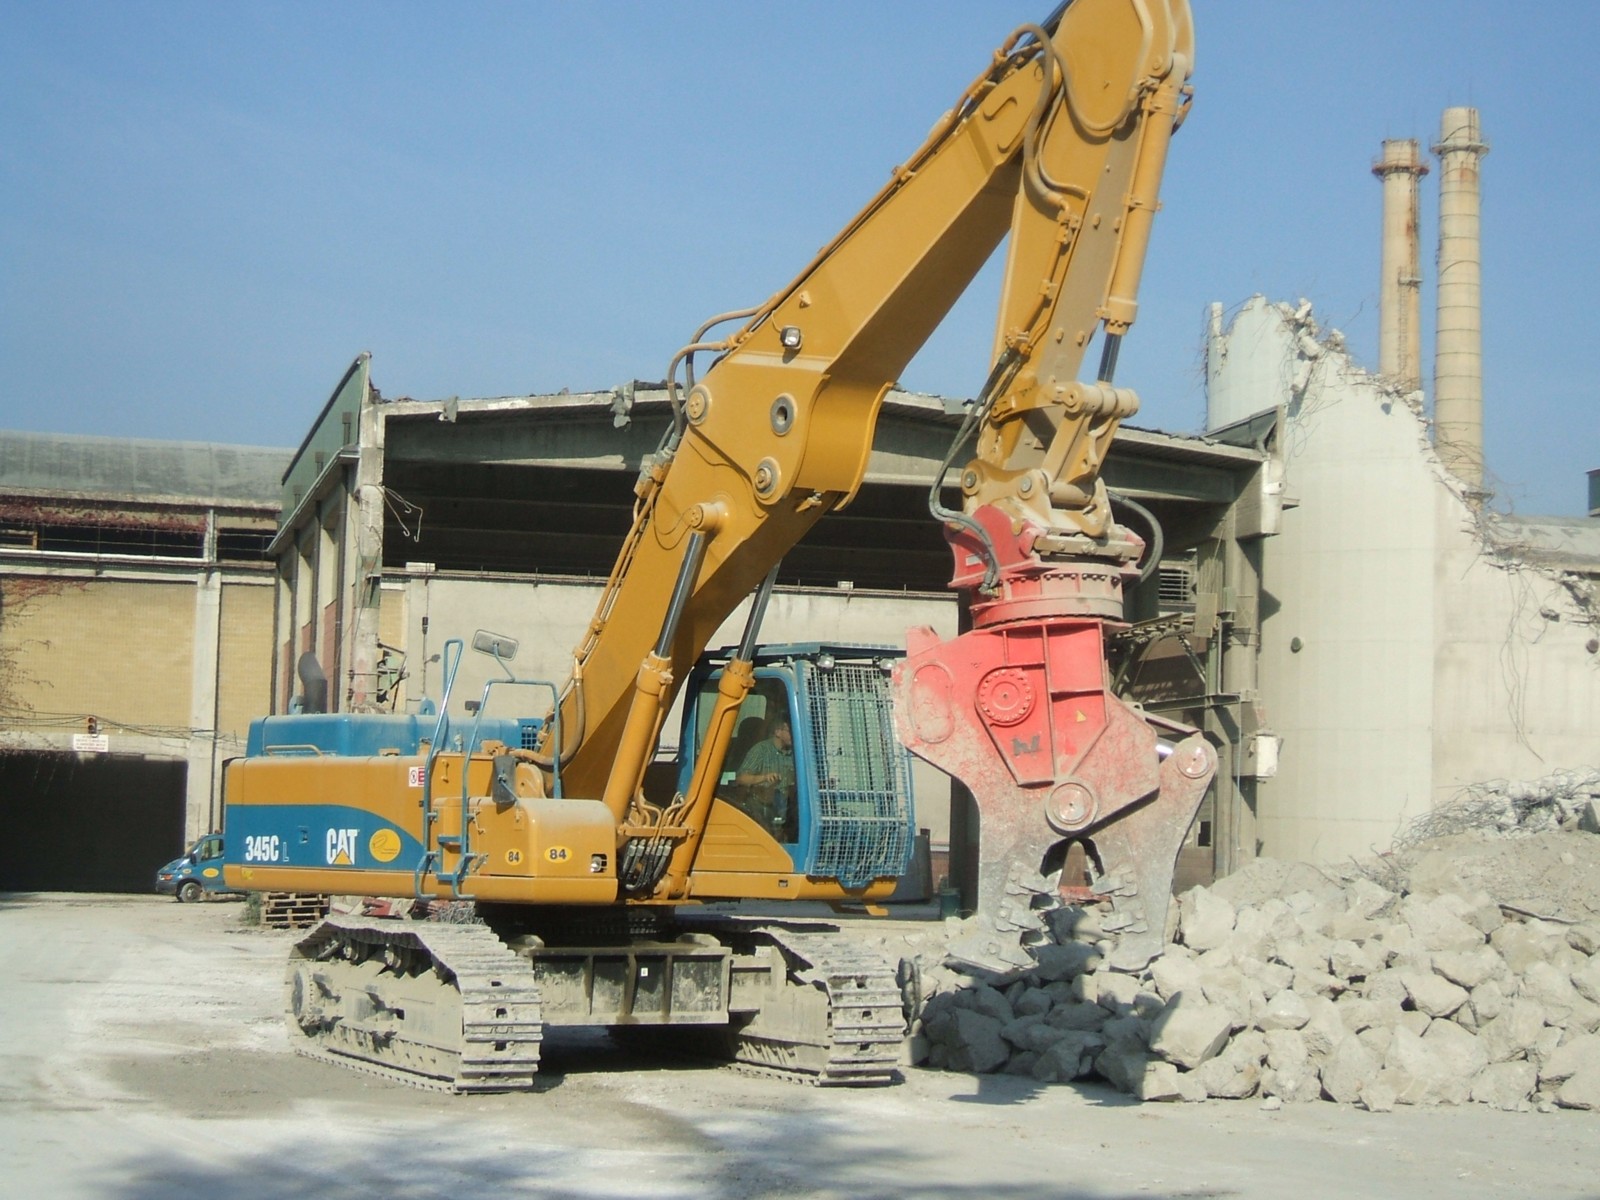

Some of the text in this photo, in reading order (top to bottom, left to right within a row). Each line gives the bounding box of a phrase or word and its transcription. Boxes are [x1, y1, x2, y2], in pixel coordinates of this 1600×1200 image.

[245, 835, 279, 861] 345C
[326, 828, 359, 865] CAT
[549, 848, 567, 860] 84
[508, 851, 520, 862] 84
